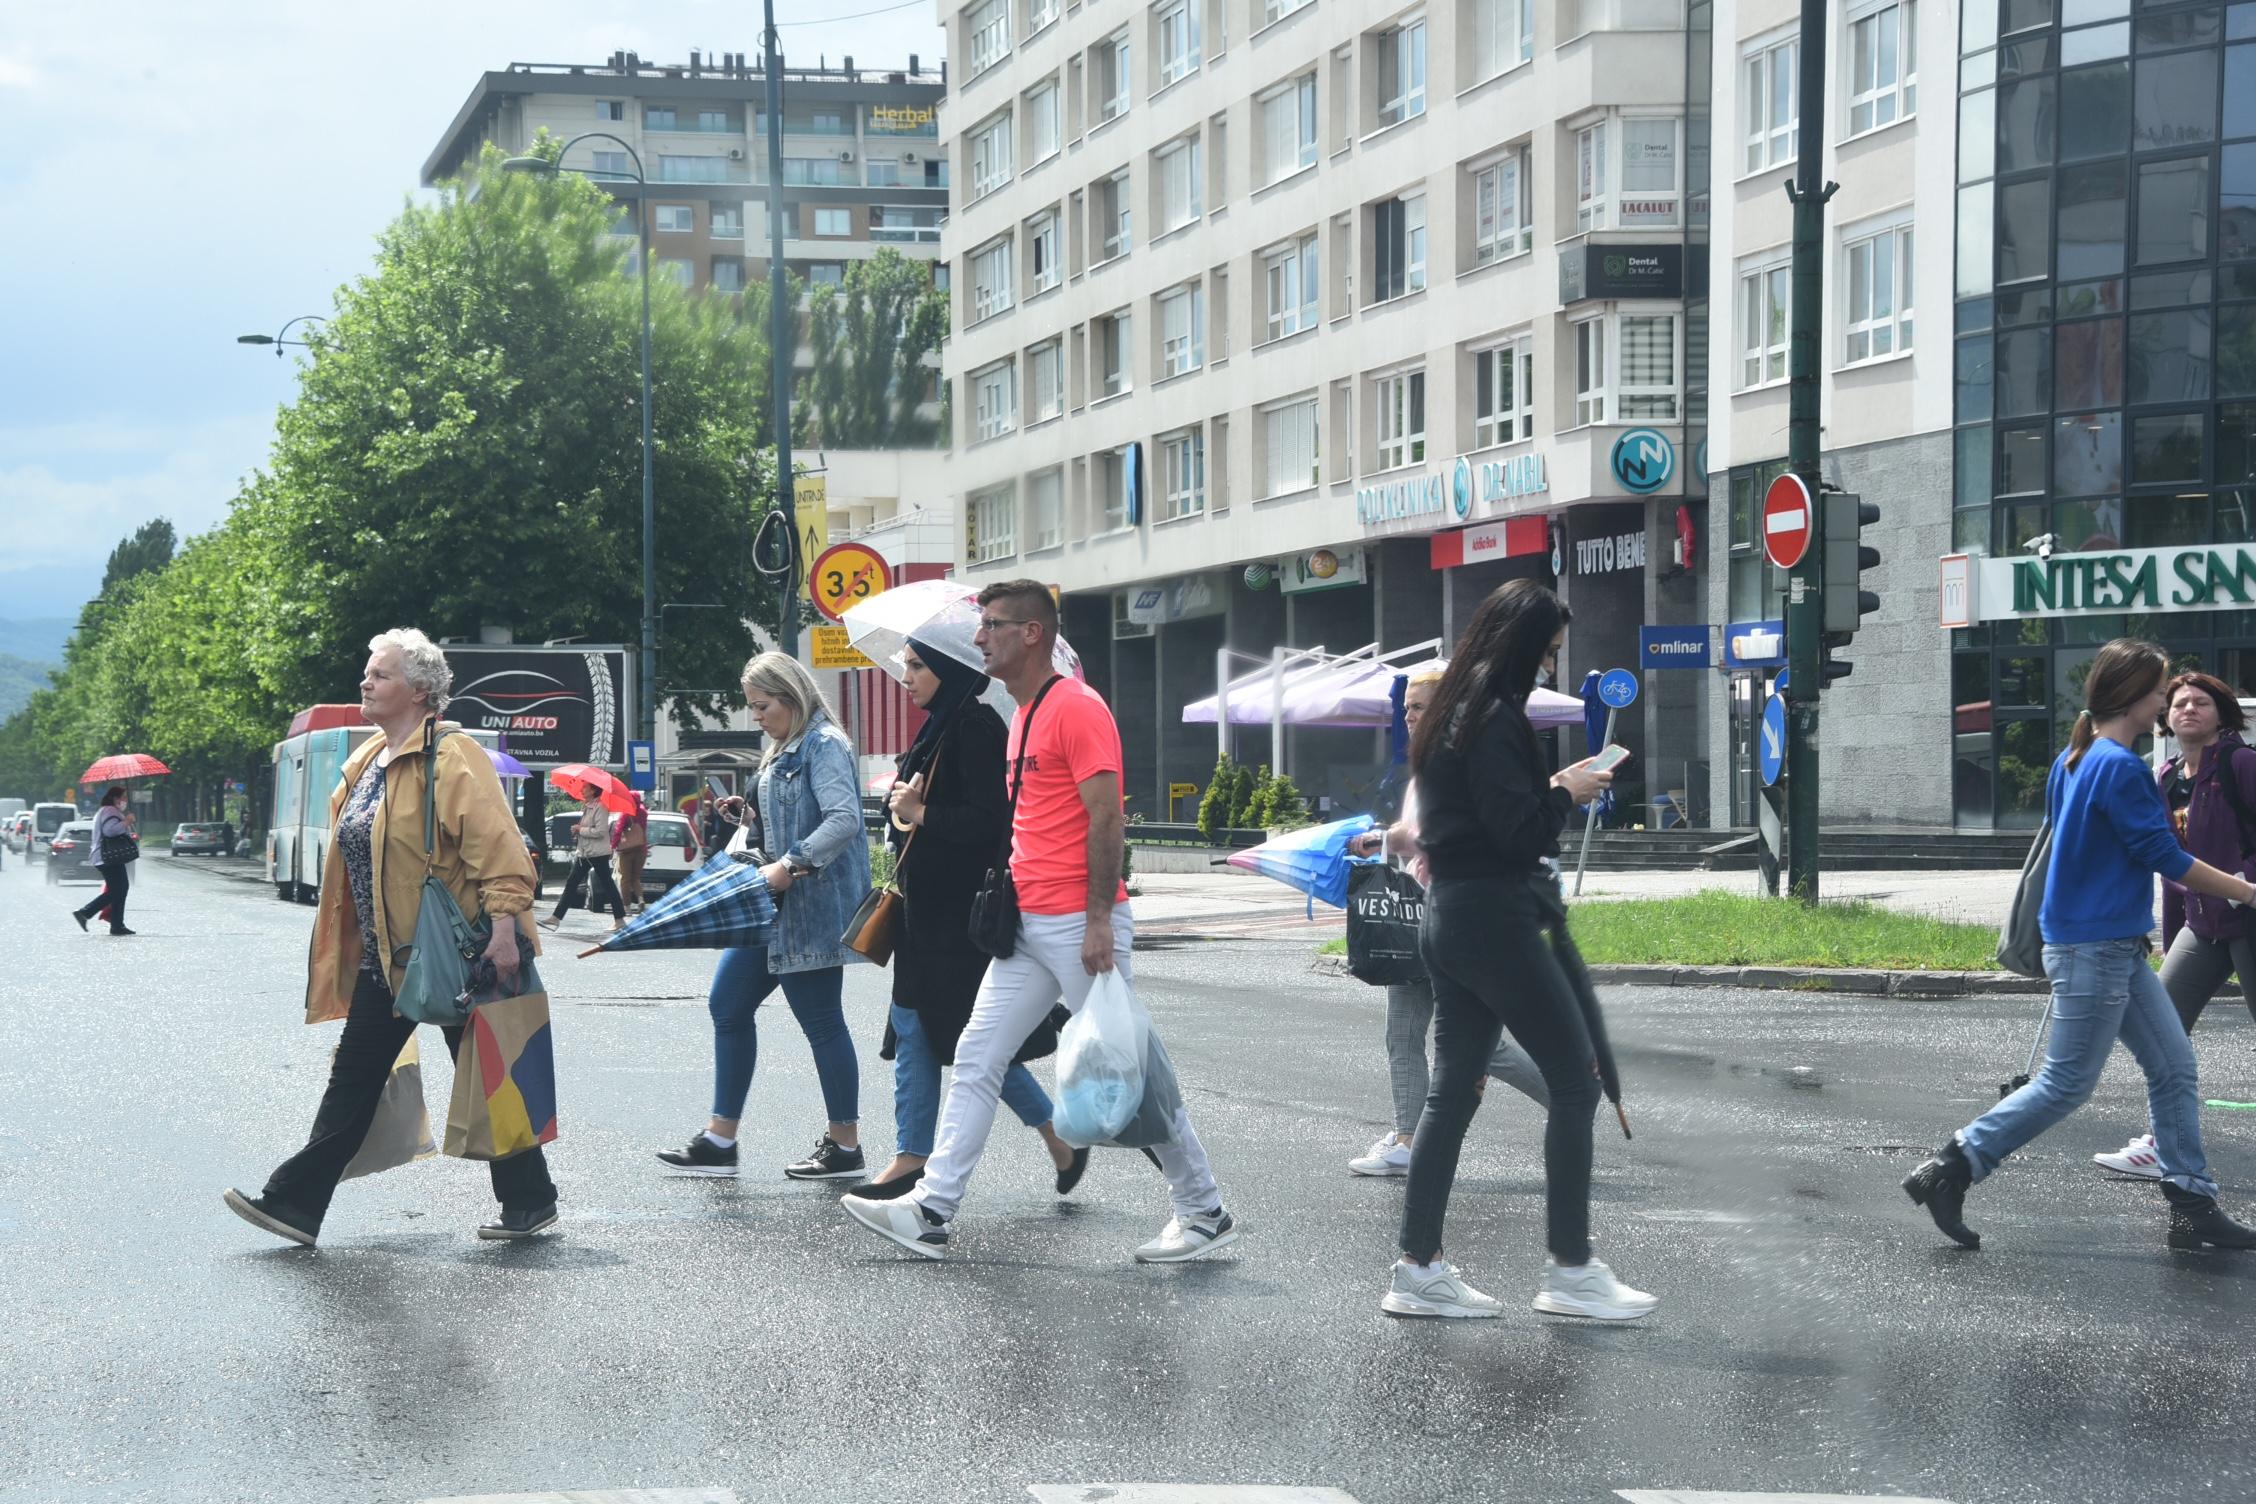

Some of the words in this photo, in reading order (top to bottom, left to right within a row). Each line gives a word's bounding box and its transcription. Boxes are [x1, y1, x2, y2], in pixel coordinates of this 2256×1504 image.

[873, 104, 933, 123] Herbal
[1622, 202, 1674, 214] LACALUT
[1628, 257, 1658, 266] Dental
[1357, 473, 1445, 524] POLIKLINIKA
[967, 501, 977, 559] NOTAR
[1577, 536, 1613, 575] TUTTO
[1616, 531, 1646, 571] BENE
[2010, 554, 2164, 612] INTESA
[1660, 640, 1704, 654] mlinar
[481, 715, 512, 728] UNI
[512, 716, 558, 729] AUTO
[535, 749, 560, 757] VOZILA
